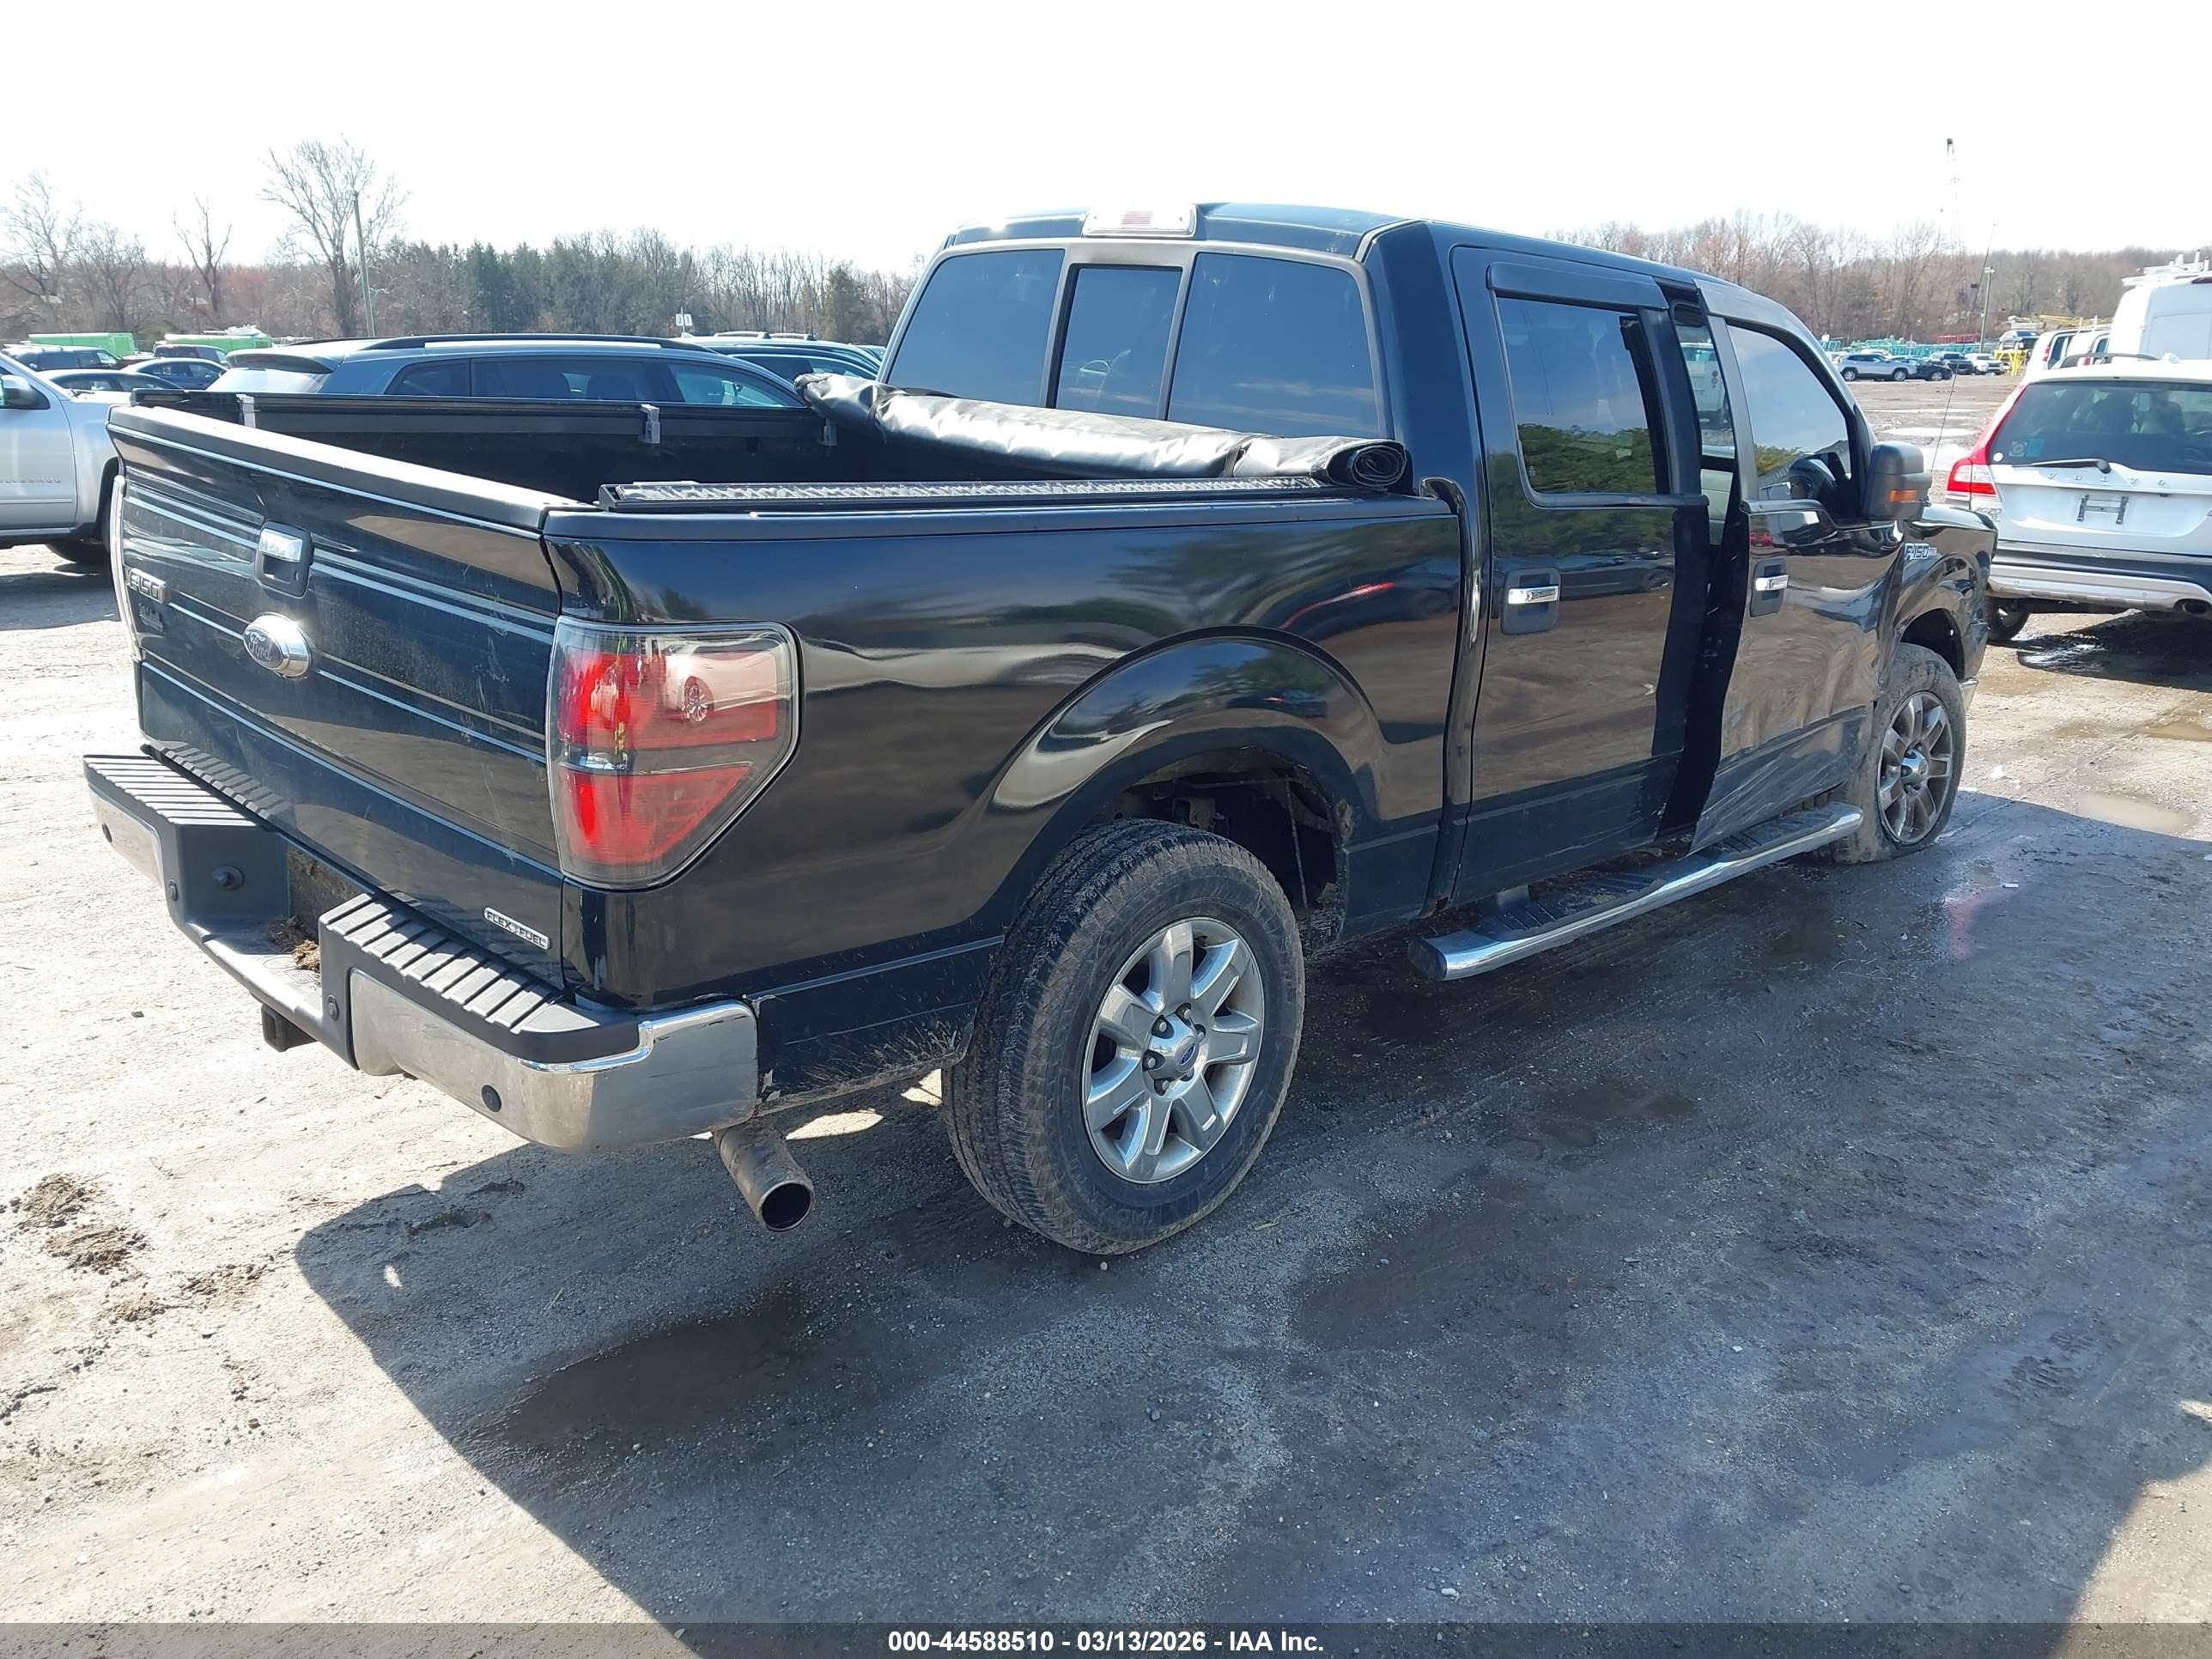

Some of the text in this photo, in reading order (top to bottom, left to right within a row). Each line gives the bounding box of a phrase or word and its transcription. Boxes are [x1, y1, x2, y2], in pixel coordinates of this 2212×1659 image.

[2047, 473, 2166, 487] VOLVO
[246, 631, 273, 661] Ford
[486, 910, 547, 946] FLEX FUEL
